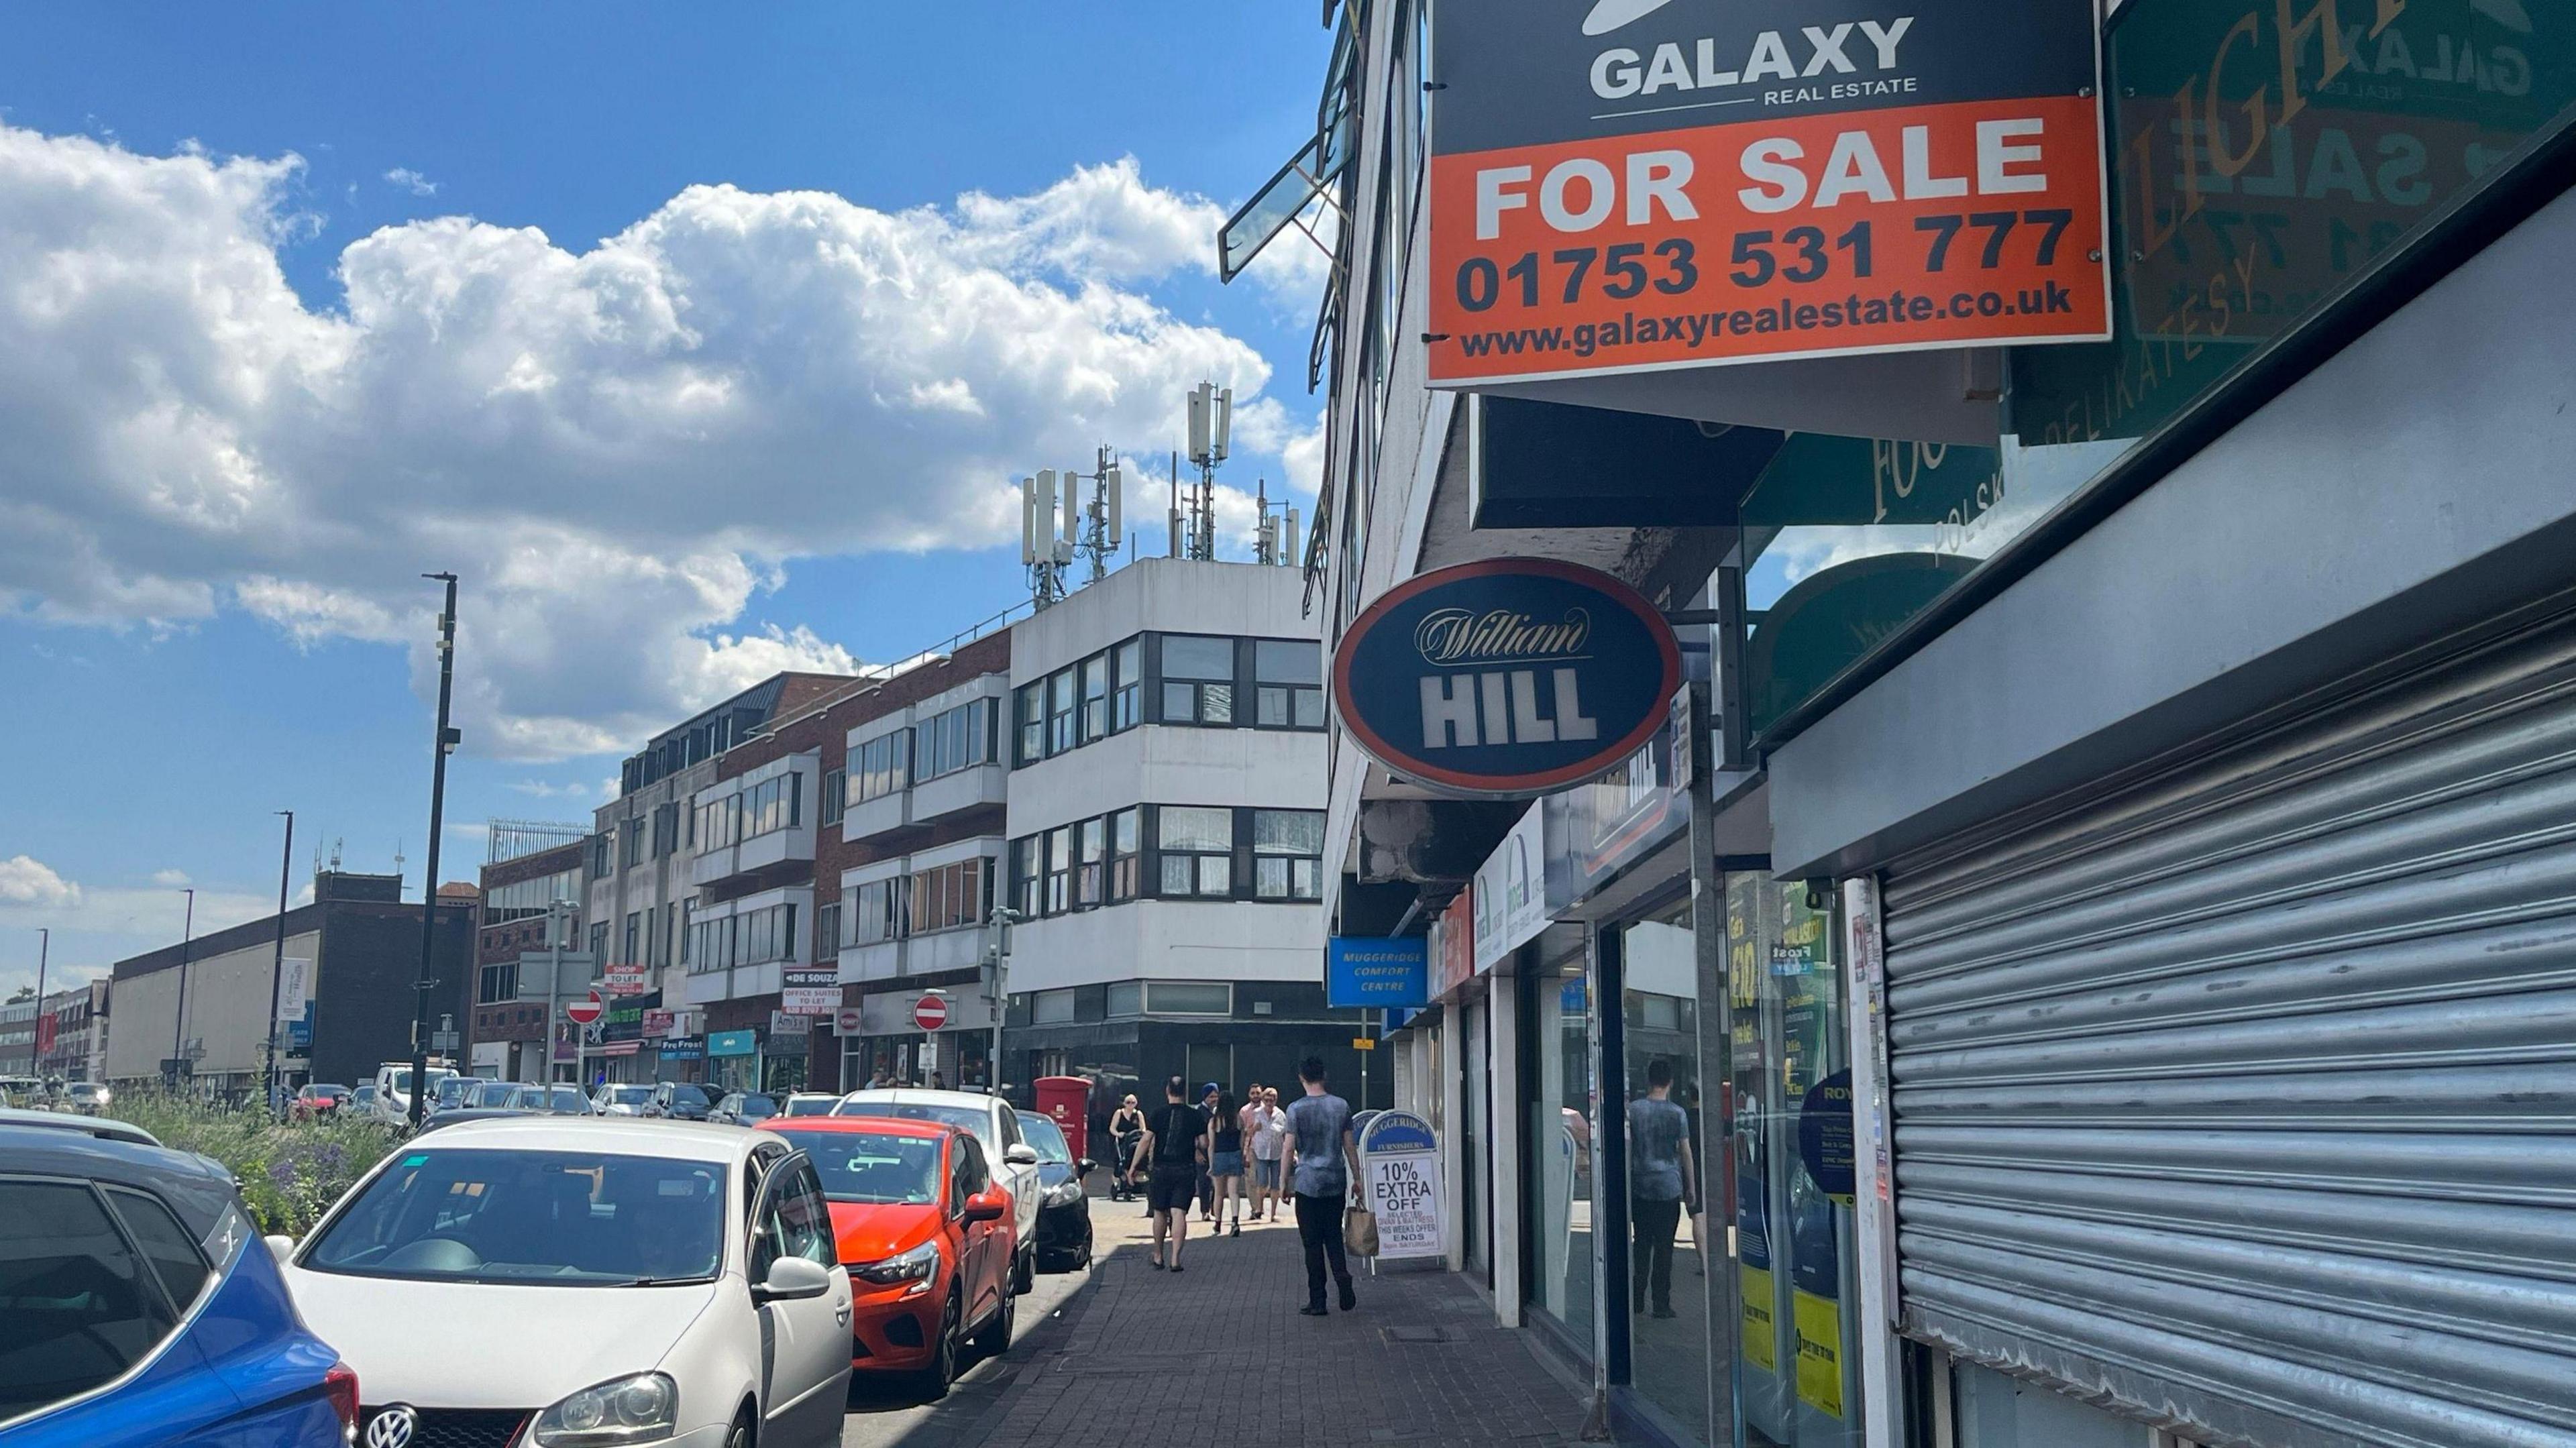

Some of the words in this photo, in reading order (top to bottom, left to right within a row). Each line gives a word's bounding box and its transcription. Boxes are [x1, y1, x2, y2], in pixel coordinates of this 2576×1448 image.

[1590, 16, 1915, 100] GALAXY
[1764, 87, 1825, 105] REAL
[1831, 78, 1917, 100] ESTATE
[1476, 150, 1699, 240] FOR
[1737, 118, 2047, 213] SALE
[1456, 237, 1699, 313] 01753
[1729, 221, 1873, 288] 531
[1914, 209, 2074, 272] 777
[1460, 280, 2072, 357] www.galaxyrealestate.co.uk
[1413, 606, 1595, 666] William
[1420, 669, 1597, 748] HILL
[1343, 952, 1422, 962] MUGGERIDGE
[793, 974, 806, 982] DE
[1354, 967, 1411, 977] COMFORT
[1361, 982, 1405, 991] CENTRE
[678, 1040, 703, 1048] Frost
[1382, 1161, 1418, 1181] 10%
[1376, 1181, 1432, 1199] EXTRA
[1387, 1198, 1421, 1211] OFF
[1393, 1233, 1425, 1241] ENDS
